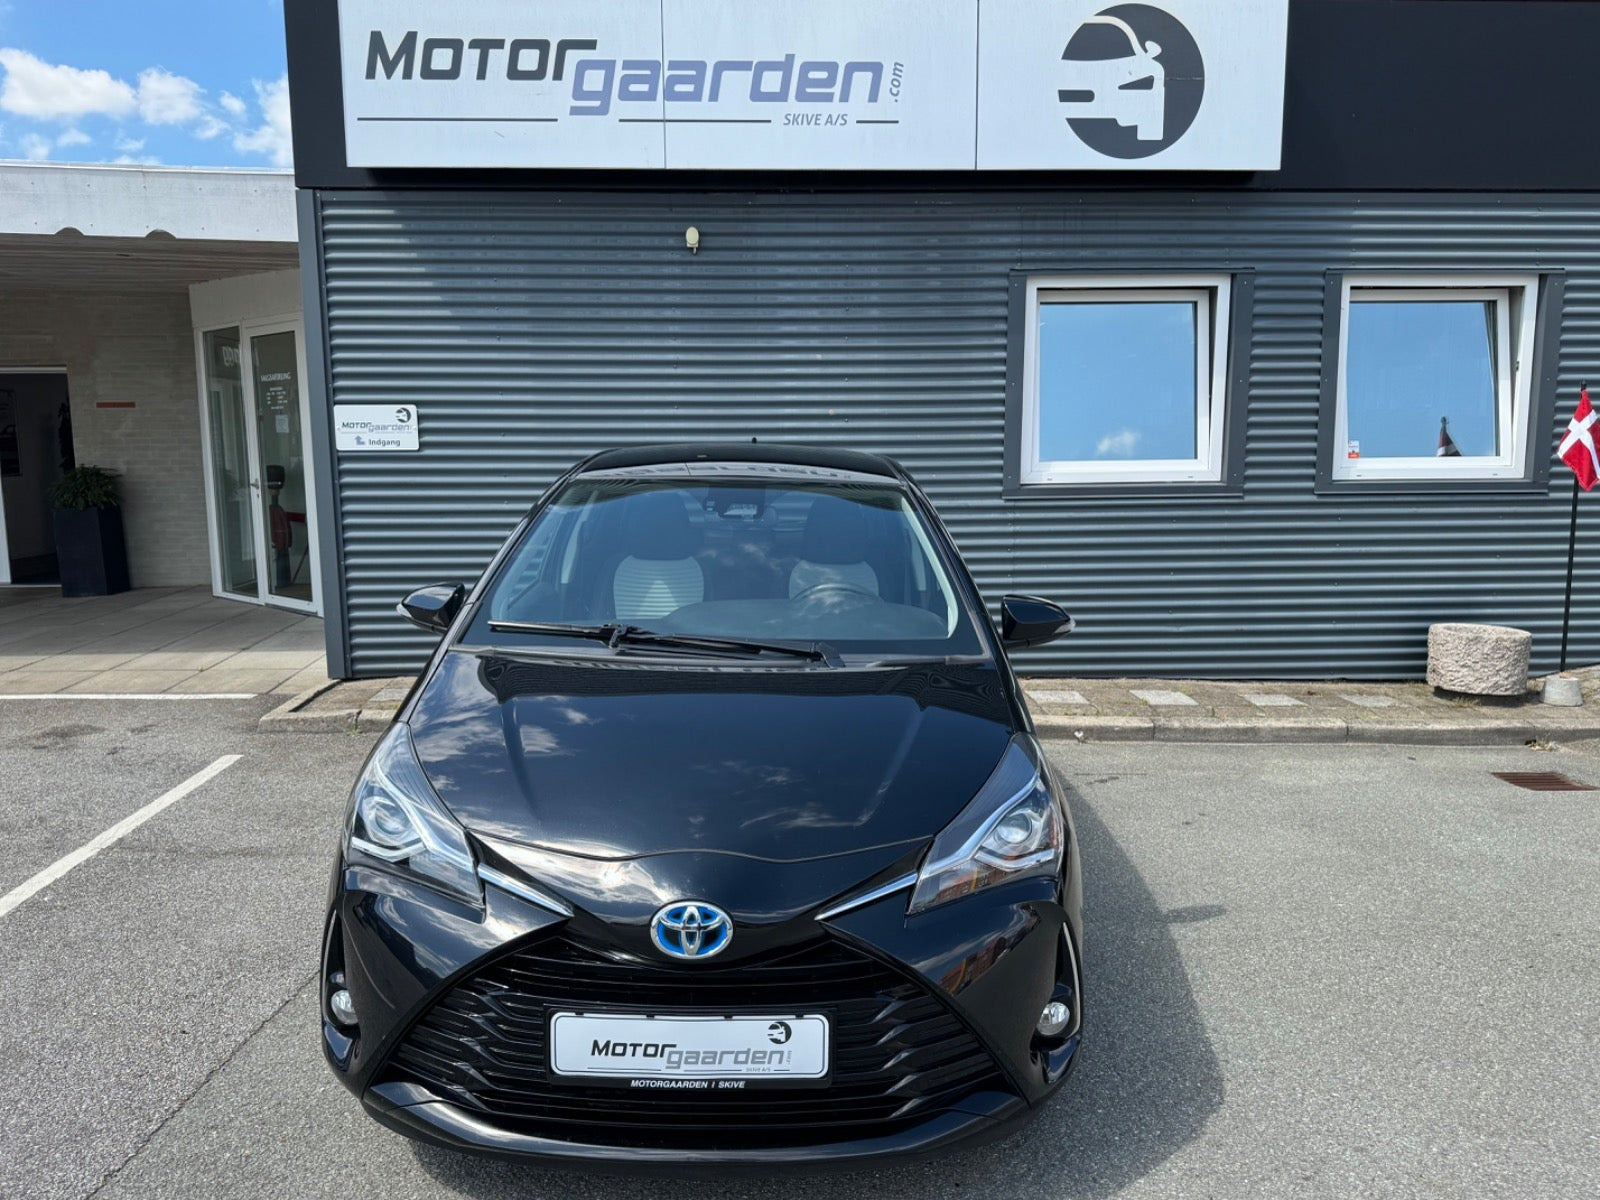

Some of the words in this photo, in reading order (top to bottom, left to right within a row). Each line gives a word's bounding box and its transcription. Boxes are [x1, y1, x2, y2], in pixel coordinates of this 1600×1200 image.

[783, 113, 822, 127] SKIVE
[824, 113, 848, 127] A/S
[369, 438, 401, 447] Indgang
[630, 1079, 708, 1089] MOTORGAARDEN
[718, 1080, 746, 1089] SKIVE
